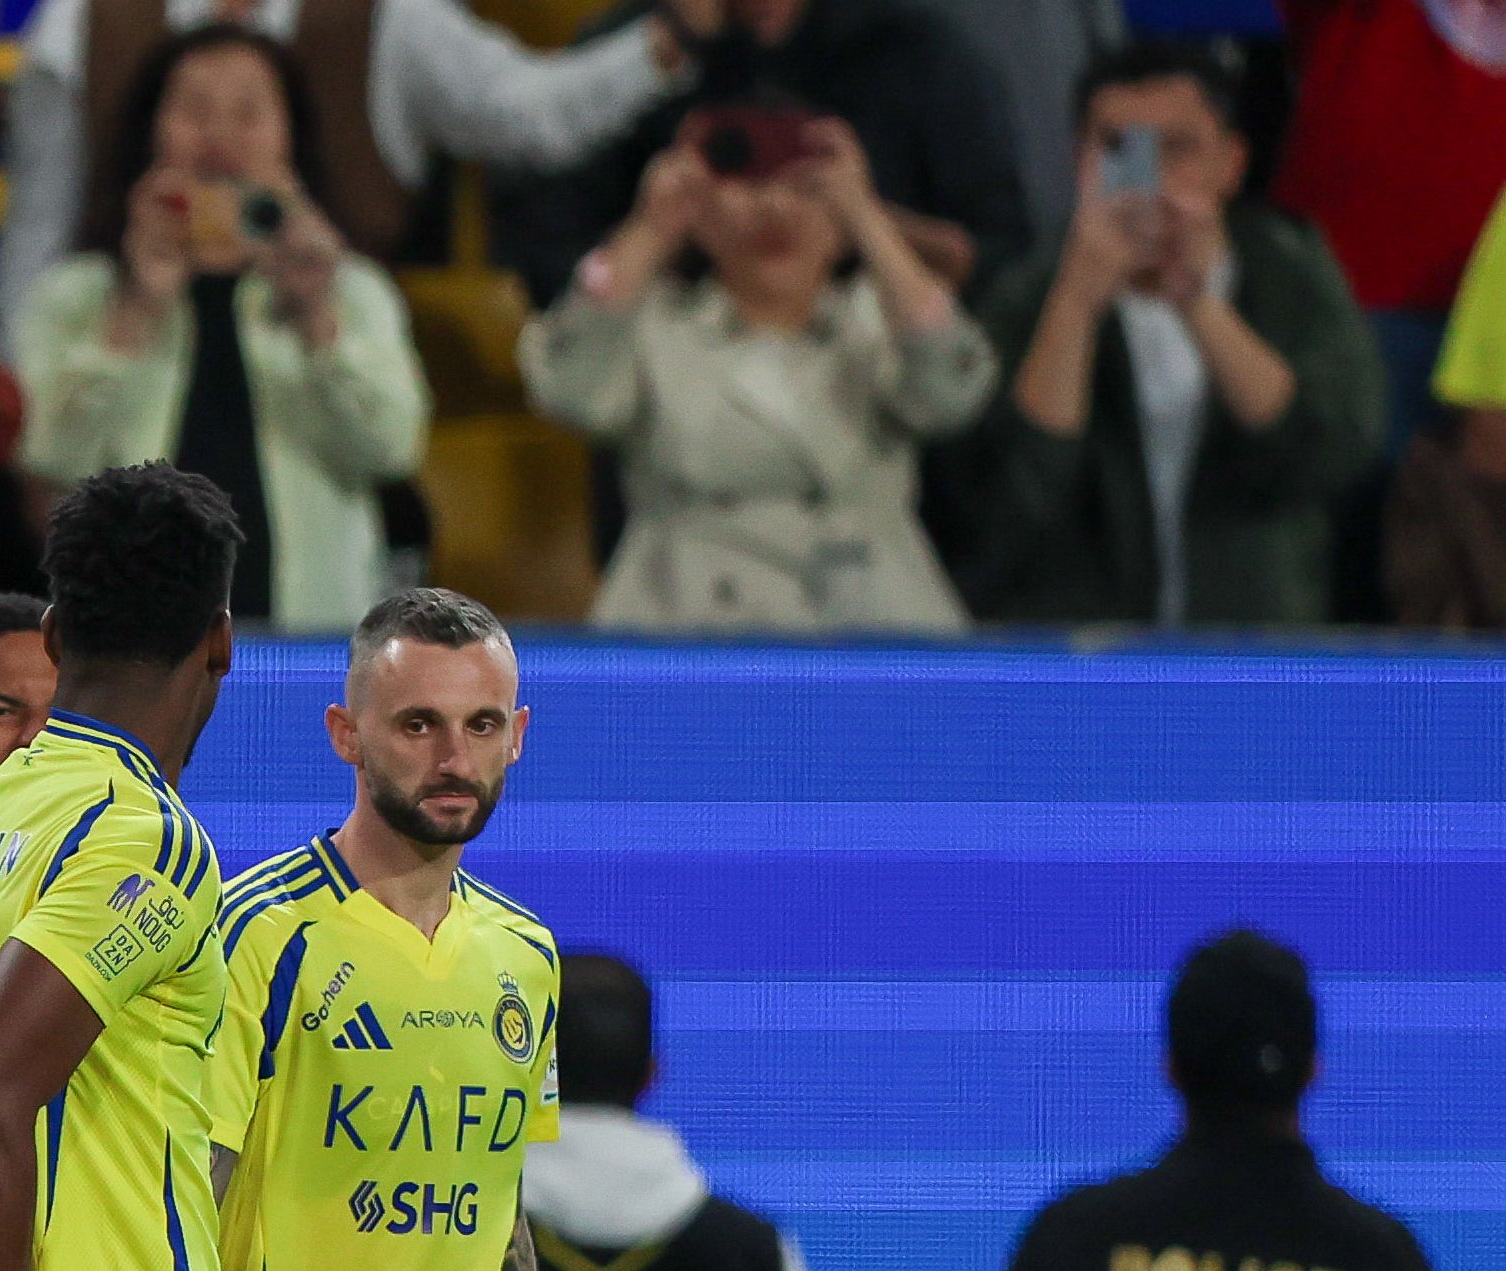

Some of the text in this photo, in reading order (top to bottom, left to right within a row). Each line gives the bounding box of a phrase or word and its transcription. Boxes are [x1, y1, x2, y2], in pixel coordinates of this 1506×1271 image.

[133, 907, 171, 953] NOUG
[401, 1010, 485, 1029] AROYA
[324, 1084, 527, 1152] KAFD
[386, 1182, 479, 1236] SHG
